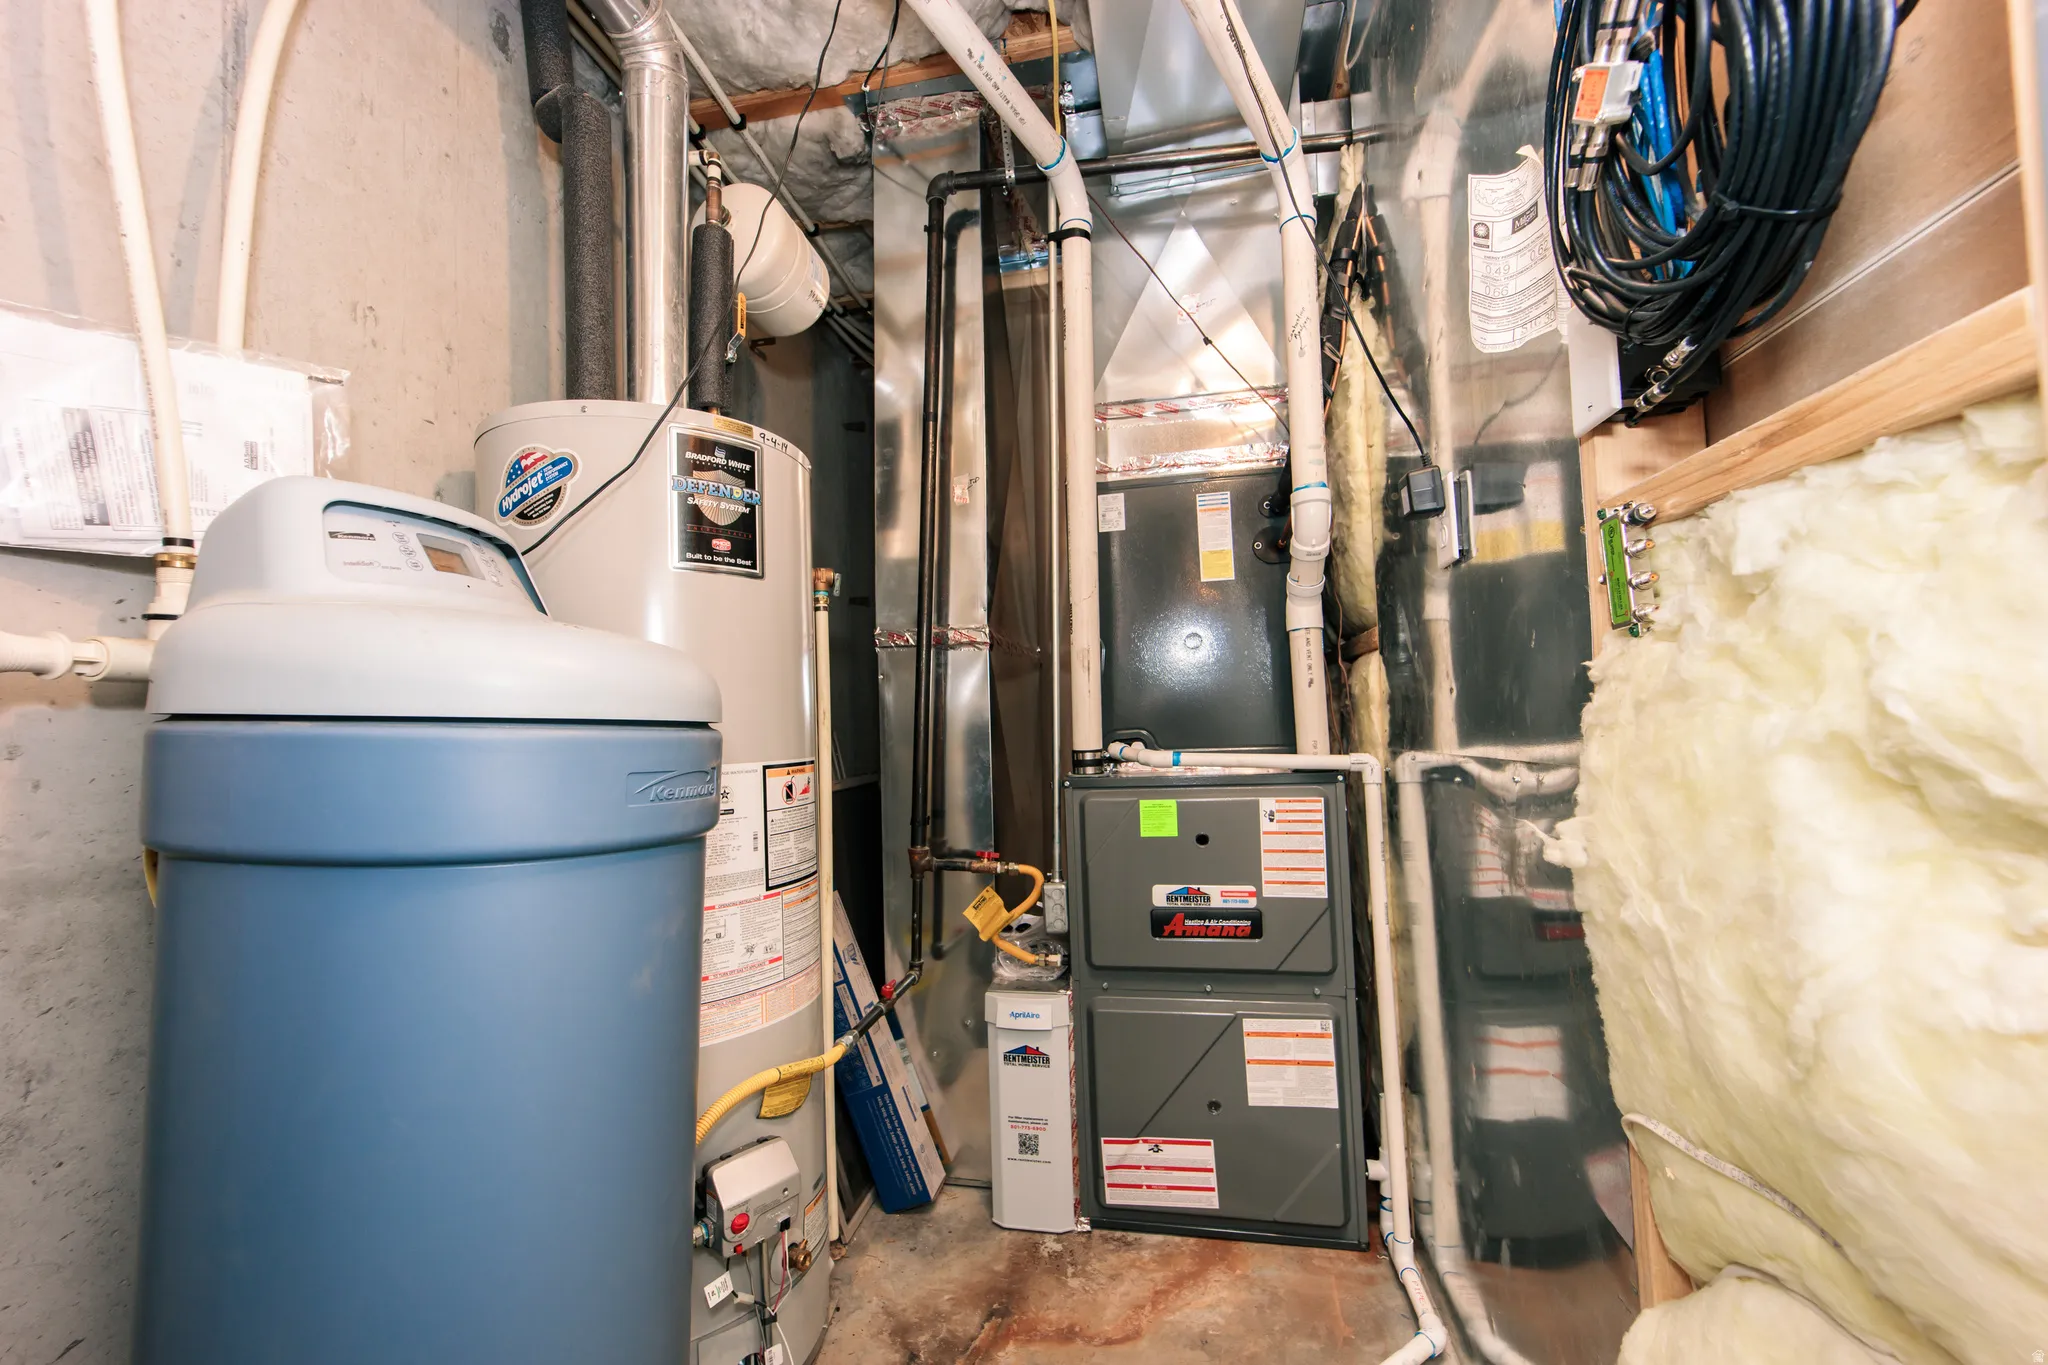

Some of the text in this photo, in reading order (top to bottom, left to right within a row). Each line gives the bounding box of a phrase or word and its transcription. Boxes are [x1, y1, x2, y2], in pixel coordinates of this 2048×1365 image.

[981, 69, 994, 83] VENT
[990, 80, 1001, 92] AND
[997, 89, 1012, 105] WASTE
[1530, 239, 1548, 261] 0.62
[1485, 264, 1510, 275] 0.49
[1485, 285, 1509, 297] 0.66
[684, 451, 752, 472] BRADFORD WHITE
[502, 472, 543, 512] Hydrojet
[672, 475, 762, 505] DEFENDER
[686, 496, 751, 514] SAFETY SYSTEM
[337, 533, 376, 541] Kenmore
[686, 552, 703, 560] Built
[724, 556, 735, 564] the
[737, 558, 753, 566] Best
[1305, 662, 1313, 676] ONLY
[650, 783, 715, 802] Kenmore
[1166, 895, 1211, 903] RENTMEISTER
[1162, 912, 1252, 937] Amana
[1009, 1010, 1041, 1020] AprilAire
[1003, 1053, 1050, 1065] RENTMEISTER
